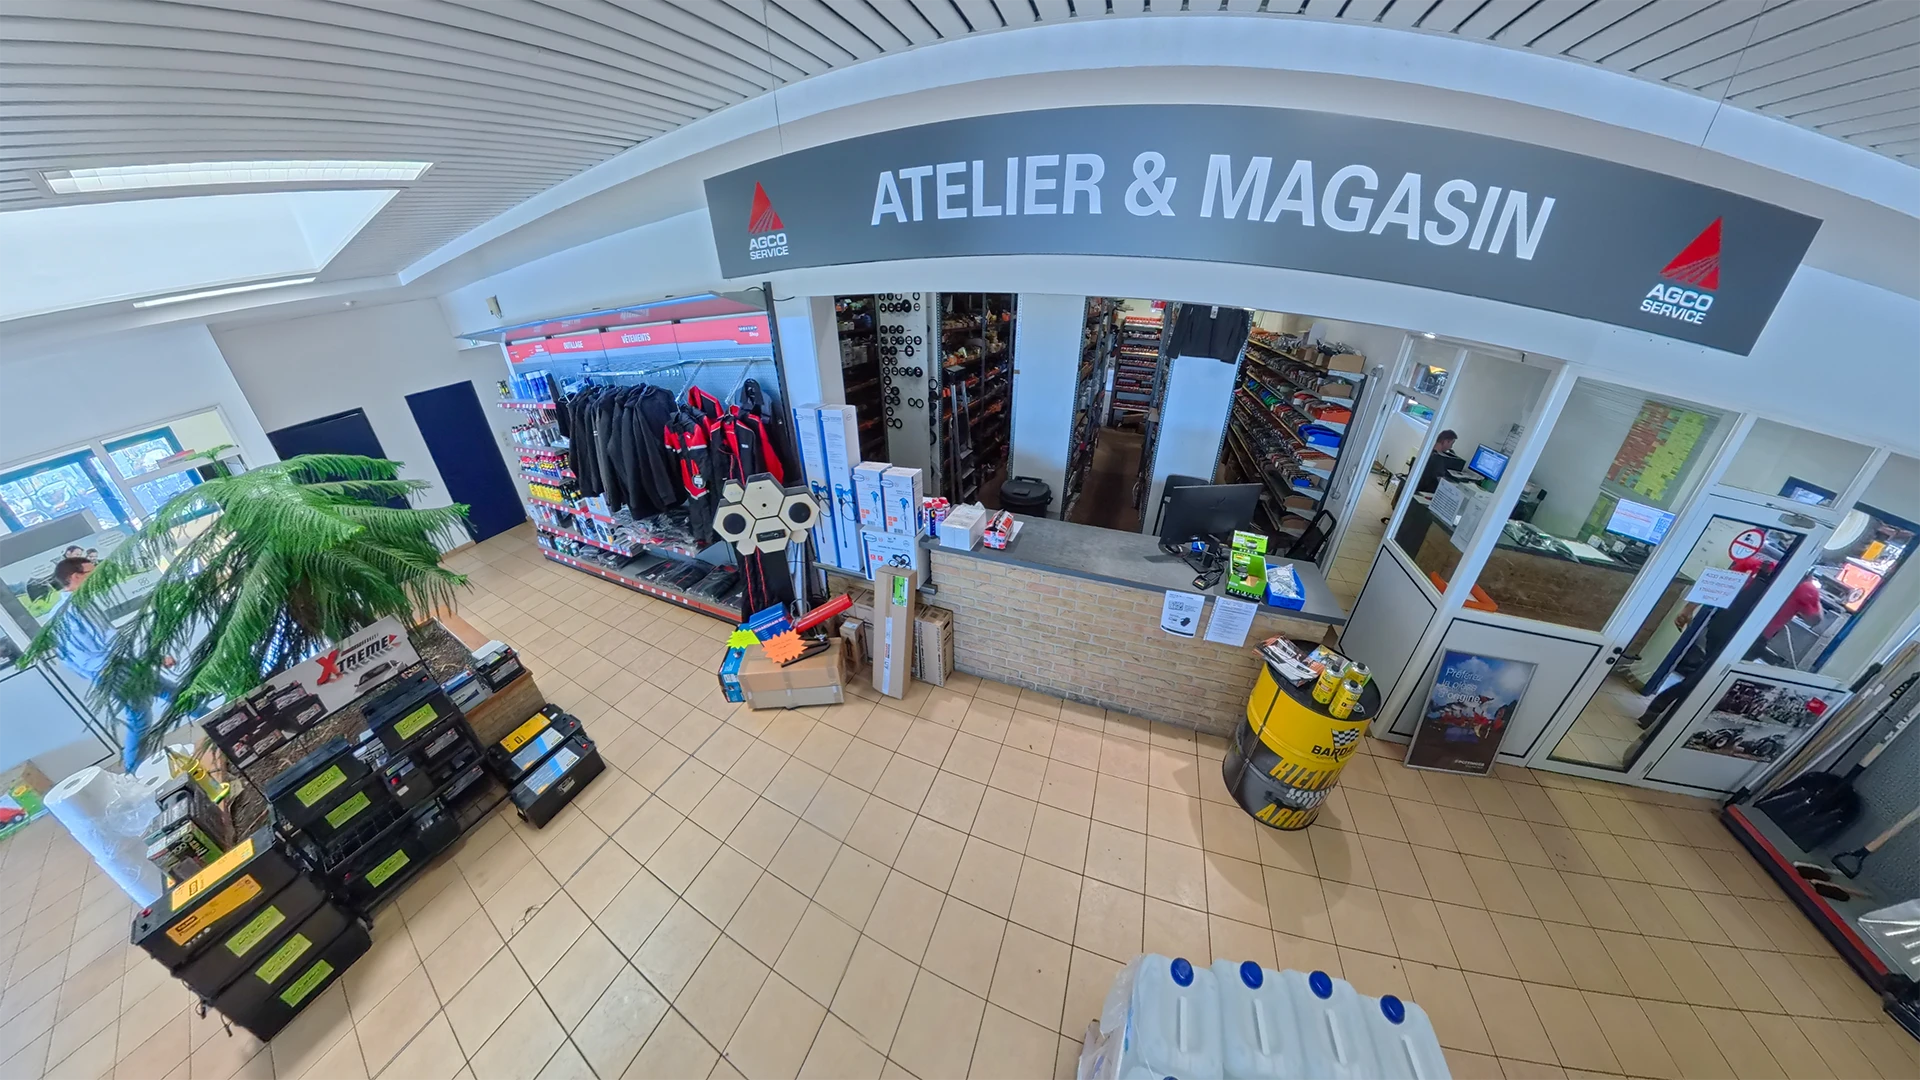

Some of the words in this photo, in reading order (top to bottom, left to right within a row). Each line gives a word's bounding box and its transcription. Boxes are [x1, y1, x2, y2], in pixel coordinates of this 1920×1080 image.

[871, 152, 1106, 226] ATELIER
[1123, 150, 1178, 217] &
[1199, 153, 1557, 261] MAGASIN
[749, 232, 788, 251] AGCO
[749, 245, 790, 260] SERVICE
[1645, 283, 1715, 312] AGCO
[1640, 299, 1707, 325] SERVICE
[1311, 743, 1355, 762] BARDA
[1269, 759, 1331, 788] RIEN
